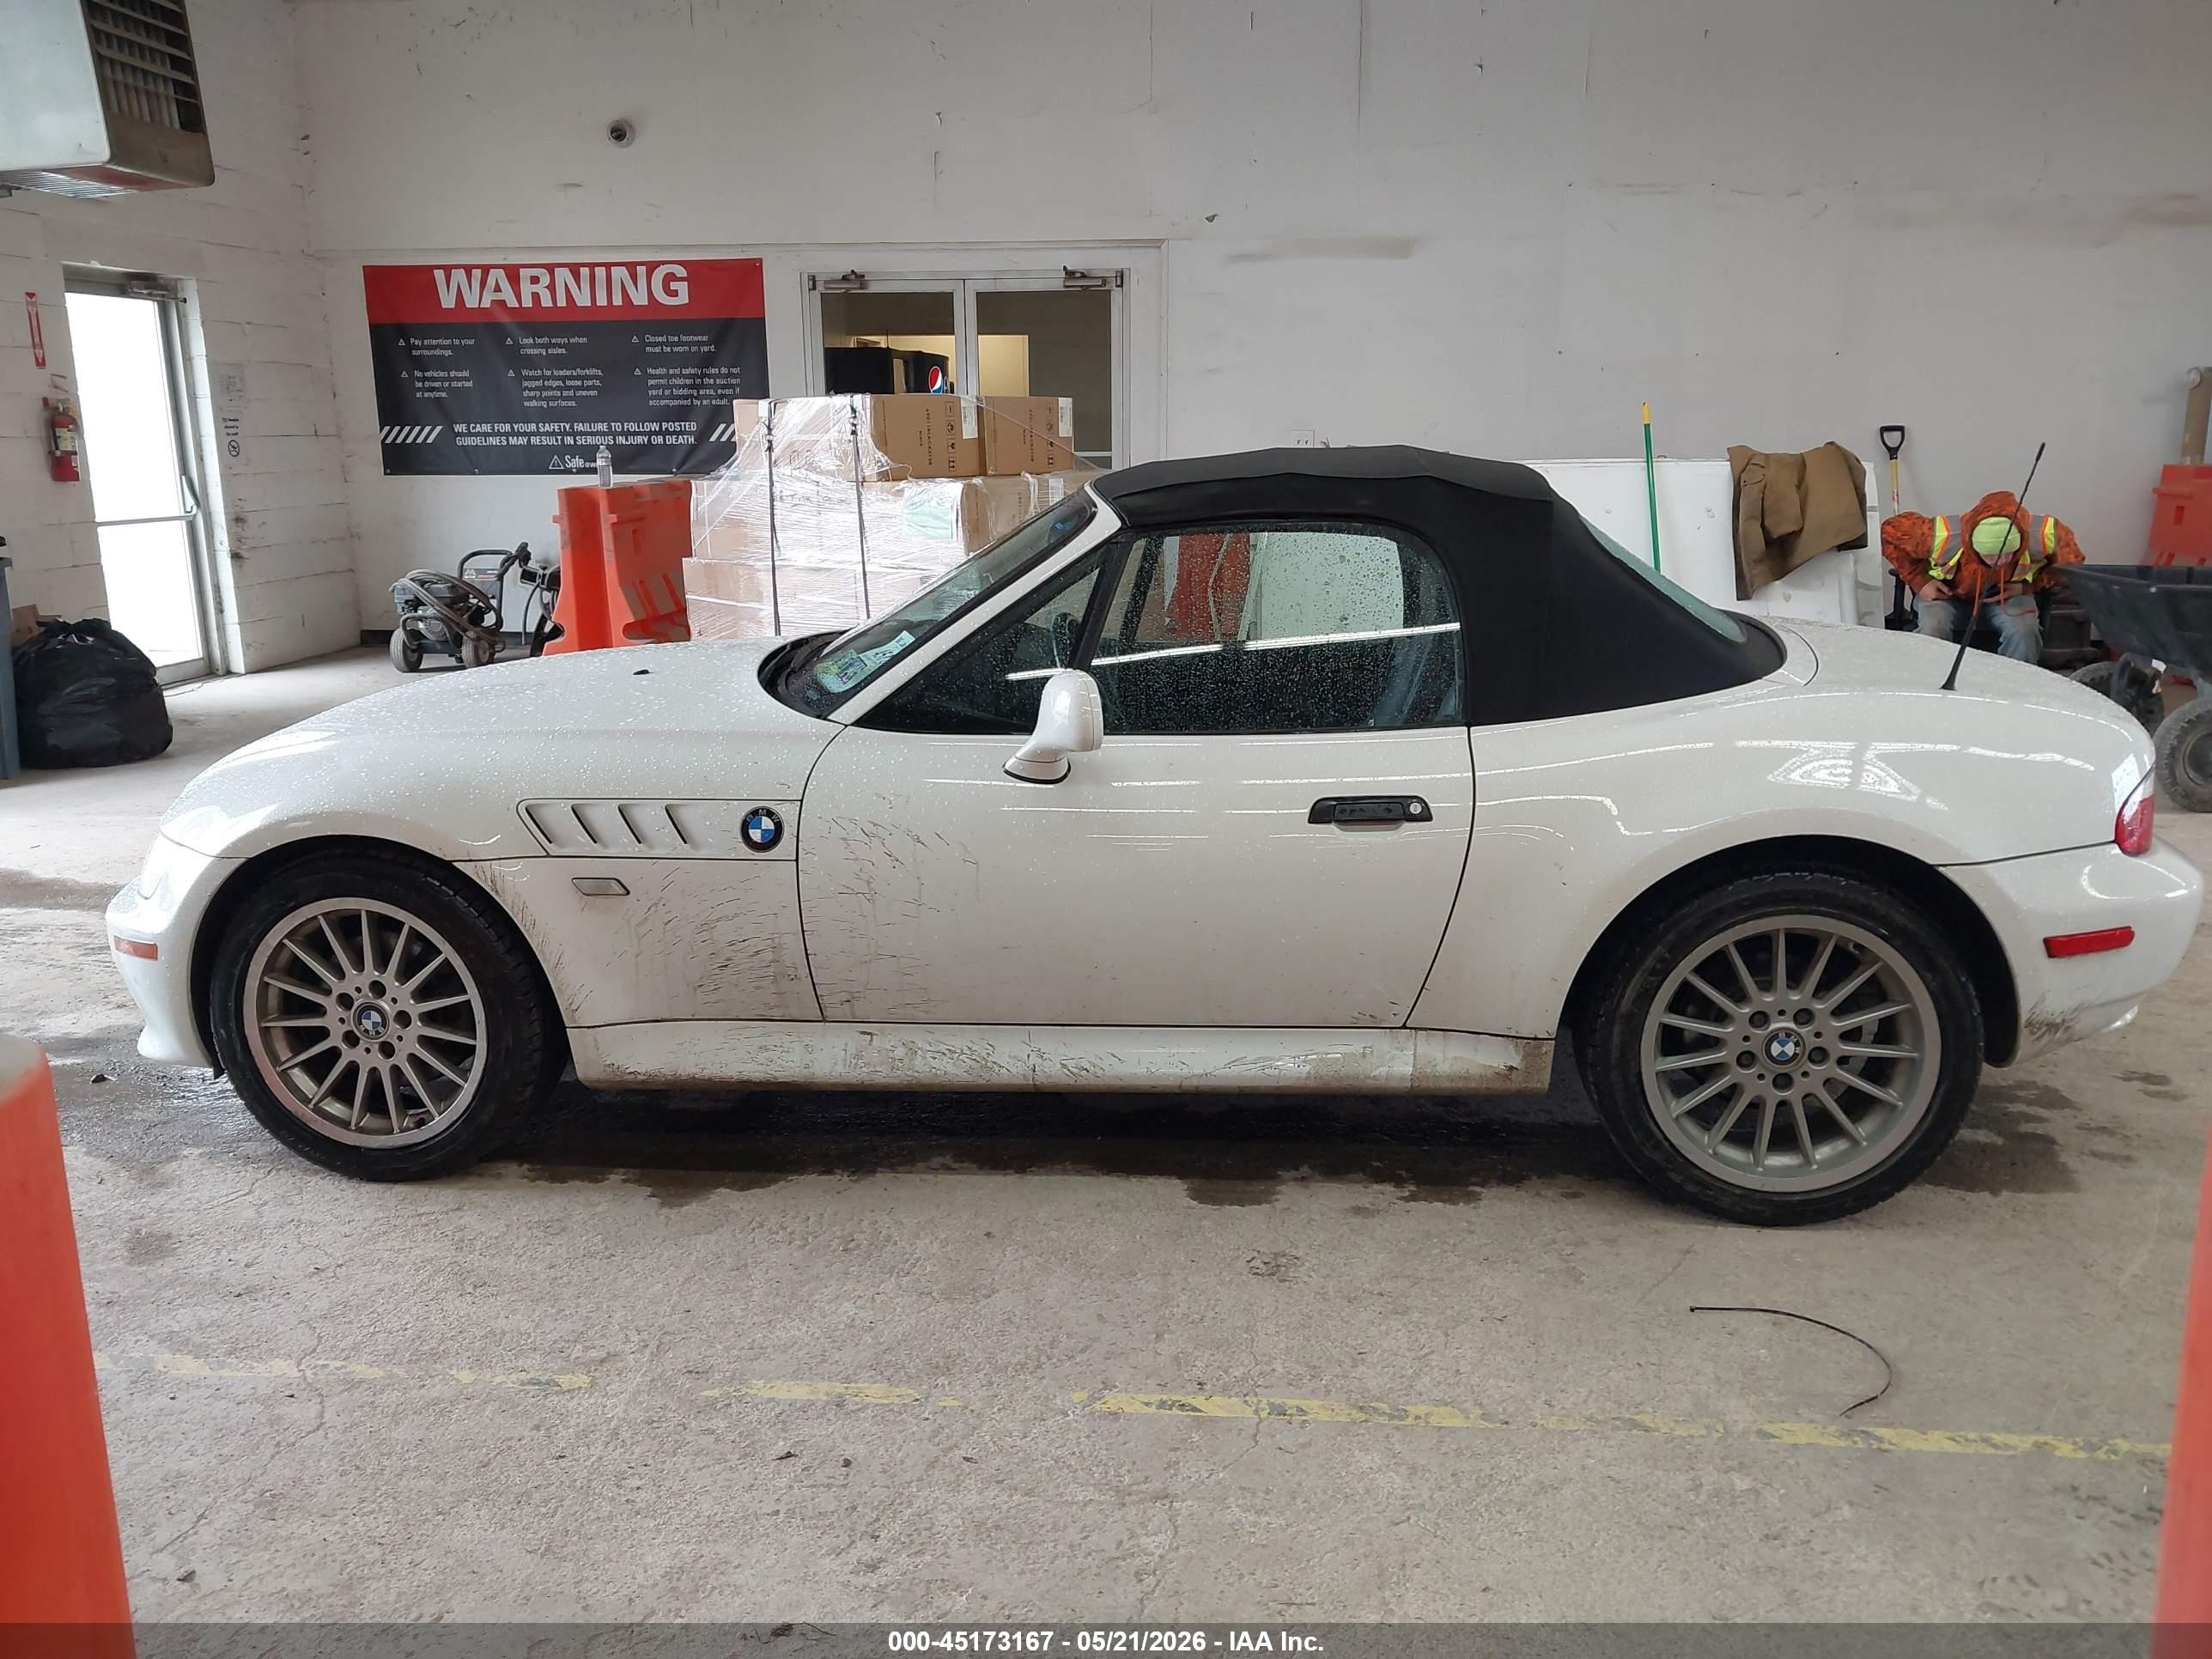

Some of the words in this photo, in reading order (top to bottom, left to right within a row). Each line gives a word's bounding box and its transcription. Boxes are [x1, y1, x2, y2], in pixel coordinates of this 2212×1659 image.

[433, 264, 690, 309] WARNING
[410, 337, 422, 347] Pay
[644, 334, 666, 343] Closed
[679, 333, 709, 342] footwear
[700, 344, 717, 353] yard.
[449, 369, 470, 378] should
[553, 368, 604, 377] loaders/forklifts,
[647, 367, 667, 375] Health
[681, 367, 702, 376] safety
[521, 379, 543, 388] jagged
[544, 379, 565, 387] edges,
[583, 379, 603, 388] parts,
[647, 378, 669, 386] permit
[522, 389, 541, 398] sharp
[541, 389, 562, 398] points
[647, 387, 663, 397] yard
[672, 387, 698, 397] bidding
[734, 386, 741, 395] if
[523, 399, 548, 409] walking
[548, 398, 578, 407] surfaces.
[648, 398, 691, 407] accompanied
[692, 398, 702, 407] by
[453, 423, 468, 433] WE
[470, 423, 493, 433] CARE
[494, 422, 512, 433] FOR
[513, 422, 538, 433] YOUR
[538, 422, 573, 433] SAFETY.
[574, 422, 610, 433] FAILURE
[611, 422, 623, 432] TO
[623, 422, 660, 432] FOLLOW
[661, 421, 697, 431] POSTED
[456, 435, 507, 446] GUIDELINES
[508, 435, 529, 446] MAY
[530, 435, 562, 446] RESULT
[563, 435, 574, 446] IN
[575, 434, 614, 446] SERIOUS
[616, 434, 649, 445] INJURY
[650, 434, 665, 445] OR
[665, 434, 698, 445] DEATH.
[745, 809, 781, 824] BMW
